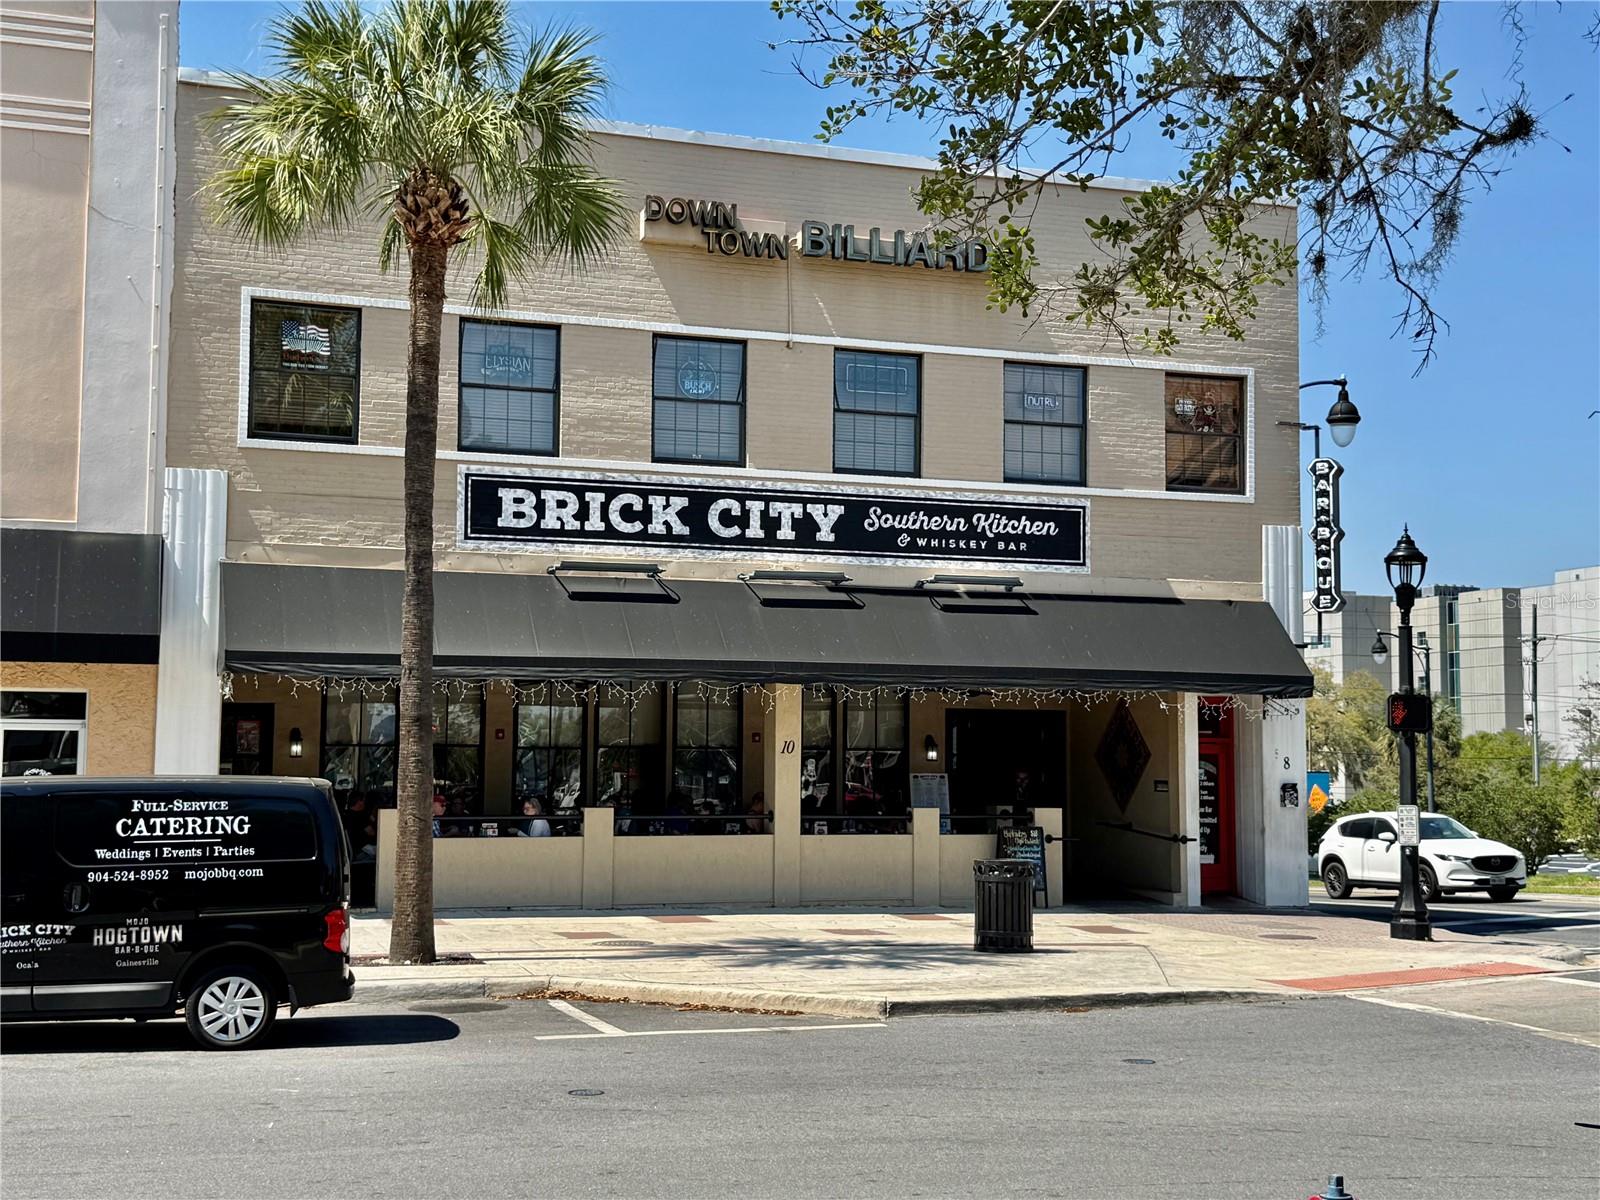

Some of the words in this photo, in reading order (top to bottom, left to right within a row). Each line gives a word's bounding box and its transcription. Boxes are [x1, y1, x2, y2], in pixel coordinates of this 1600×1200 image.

[644, 195, 738, 229] DOWN
[702, 229, 789, 260] TOWN
[497, 487, 691, 536] BRICK
[707, 498, 845, 542] CITY
[863, 506, 969, 532] Southern
[972, 512, 1059, 538] Kitchen
[897, 533, 911, 547] &
[916, 537, 988, 550] WHISKEY
[997, 541, 1028, 551] BAR
[780, 740, 795, 754] 10
[1283, 756, 1291, 770] 8
[115, 815, 252, 838] CATERING
[94, 848, 151, 861] Weddings
[162, 847, 203, 858] Events
[213, 845, 255, 857] Parties
[87, 869, 169, 883] 904-524-8952
[184, 867, 264, 882] mojobbq.com
[126, 917, 149, 926] MOJO
[0, 924, 31, 938] ICK
[35, 923, 77, 936] CITY
[93, 924, 183, 946] HOGTOWN
[115, 958, 160, 967] Gainesville
